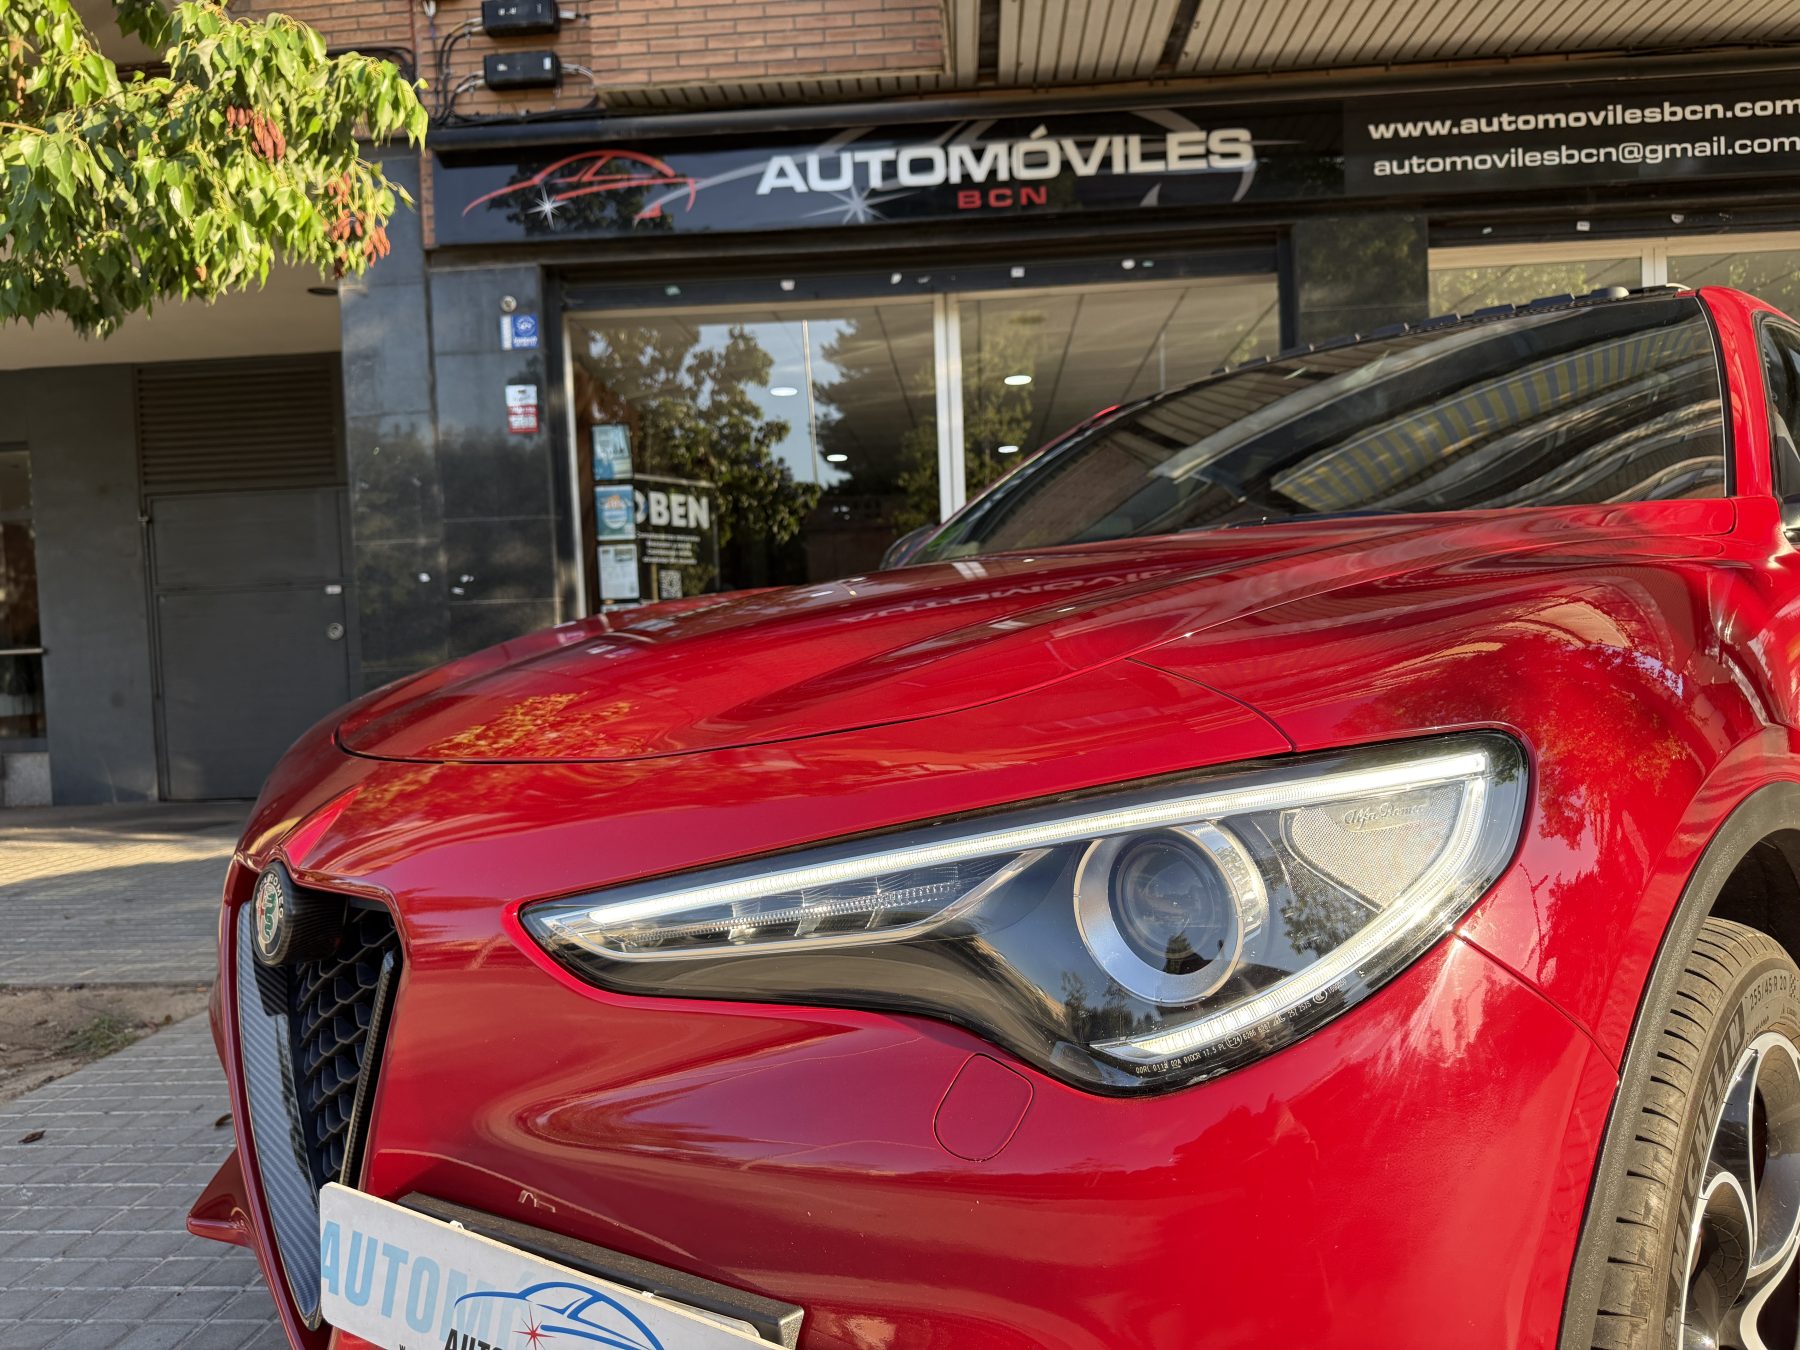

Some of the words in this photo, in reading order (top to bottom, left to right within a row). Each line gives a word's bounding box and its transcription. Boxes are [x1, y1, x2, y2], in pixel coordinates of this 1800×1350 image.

[1368, 98, 1800, 139] www.automovilesbcn.com
[756, 124, 1253, 195] AUTOMÓVILES
[1373, 135, 1800, 176] automovilesbcn@gmail.com
[957, 186, 1047, 209] BCN
[1344, 806, 1378, 829] Alfa
[267, 872, 284, 918] ROMEO
[1749, 977, 1772, 1012] 255/45
[1773, 975, 1778, 991] R
[1779, 975, 1787, 991] 20
[1671, 1011, 1742, 1291] MICHELIN
